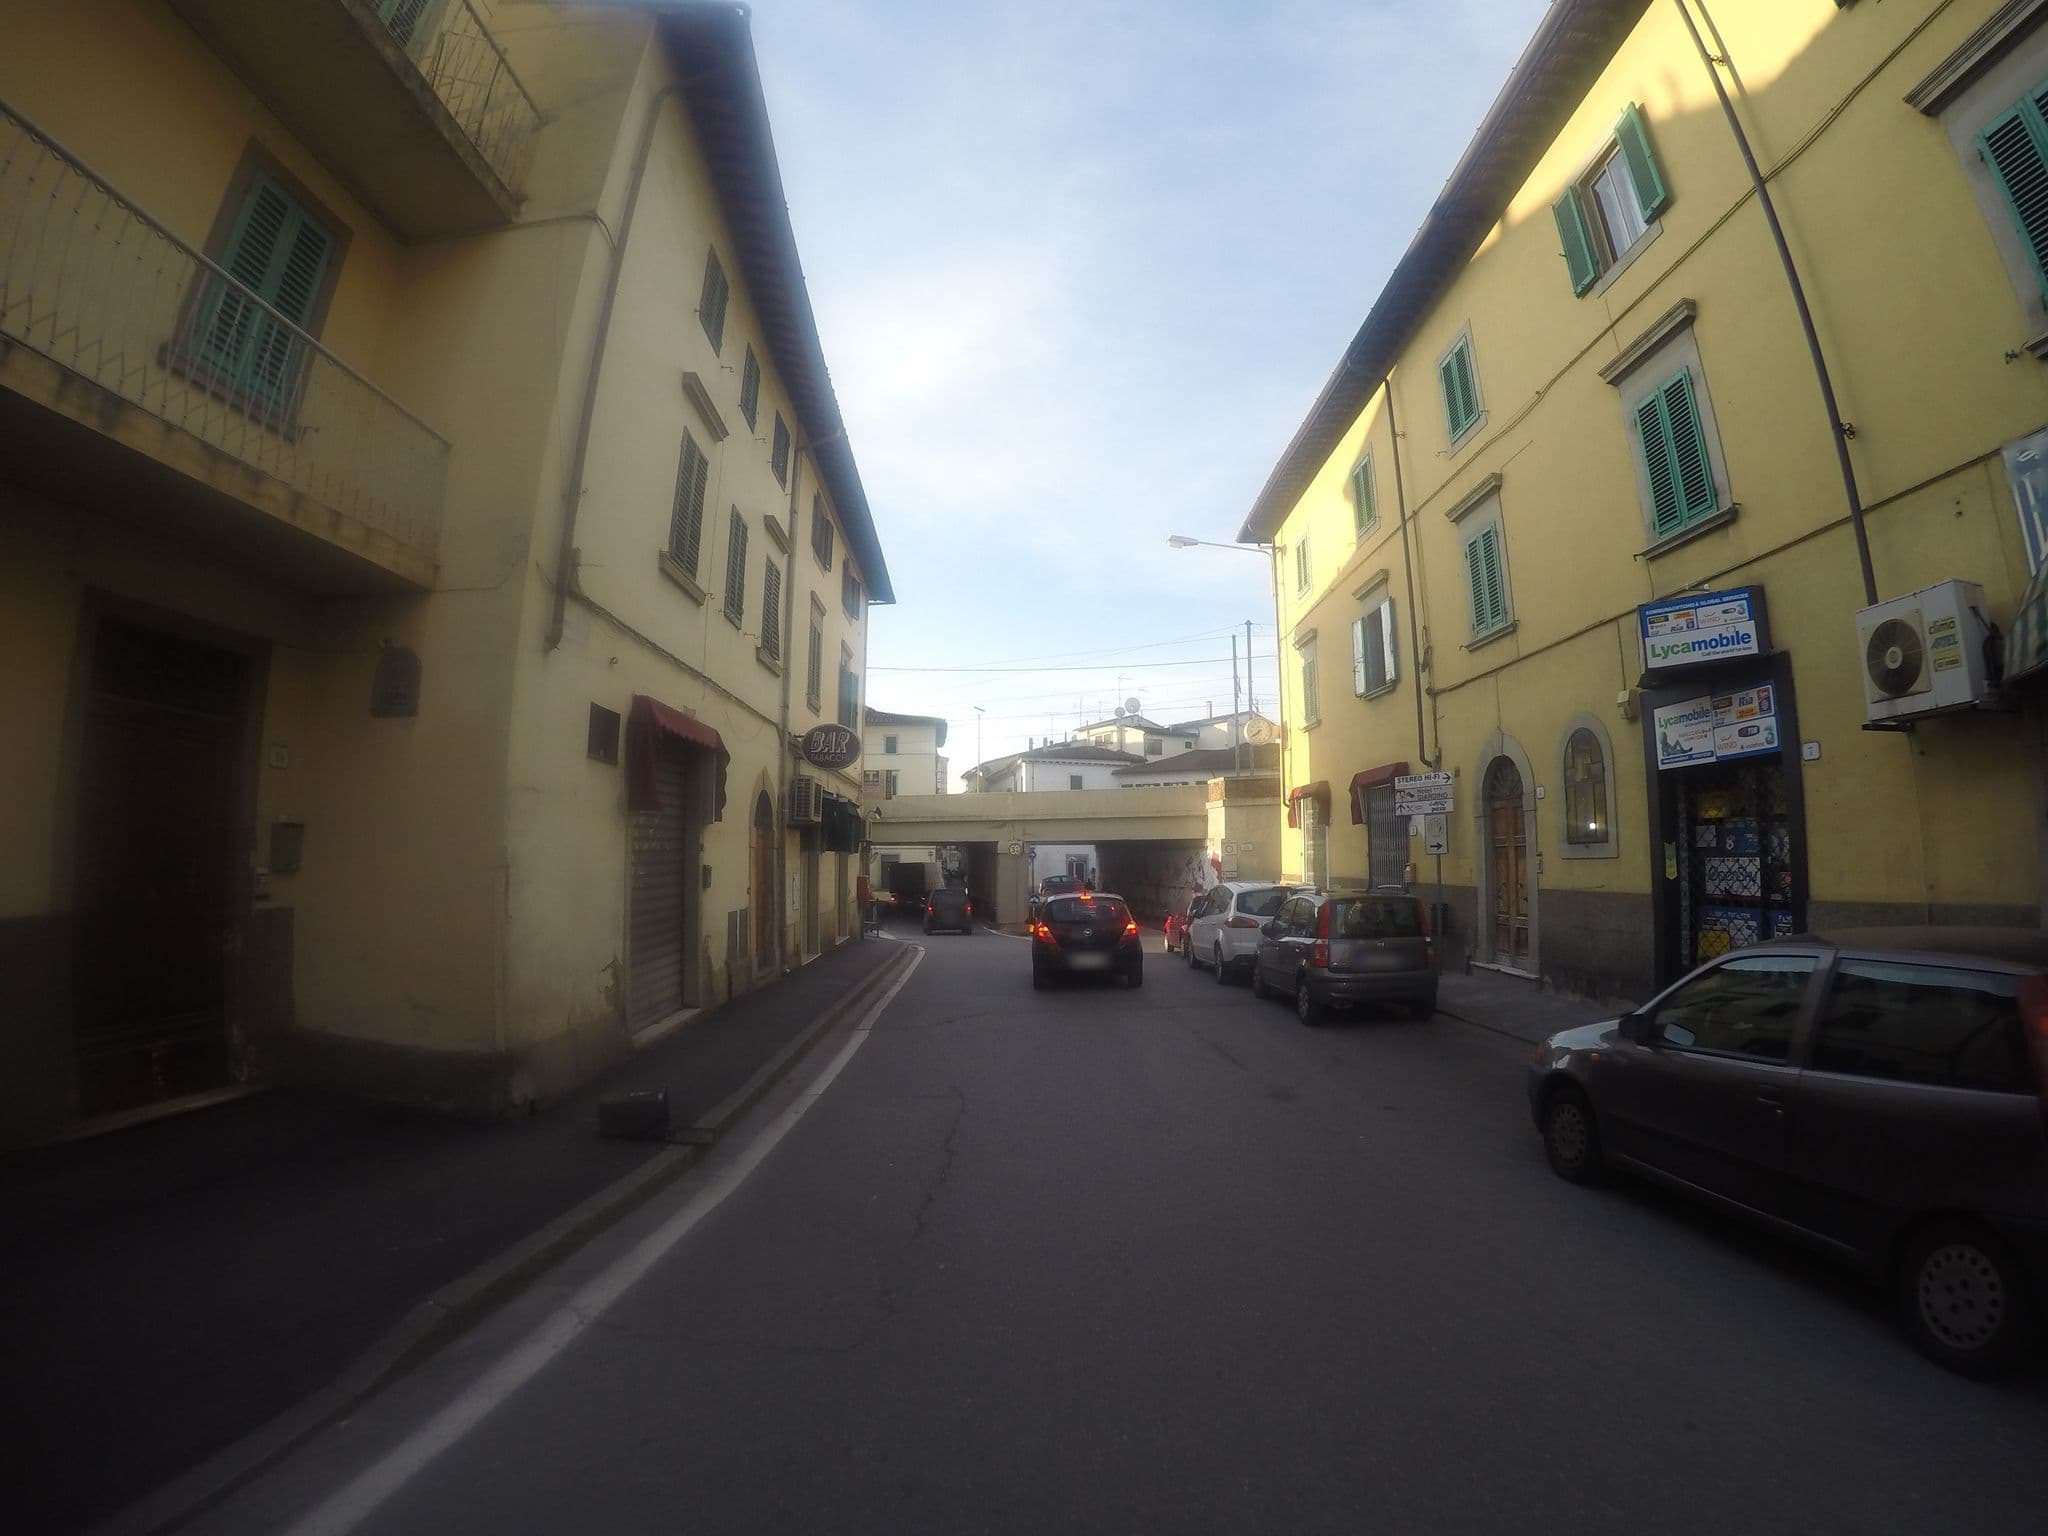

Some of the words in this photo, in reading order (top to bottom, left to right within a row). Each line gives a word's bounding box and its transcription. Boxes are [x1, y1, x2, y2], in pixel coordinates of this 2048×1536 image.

[1651, 631, 1751, 660] Lycamobile
[1658, 706, 1711, 729] Lycamobile
[810, 731, 850, 753] BAR
[810, 753, 850, 762] TABACCHI
[1397, 775, 1423, 783] STEREO
